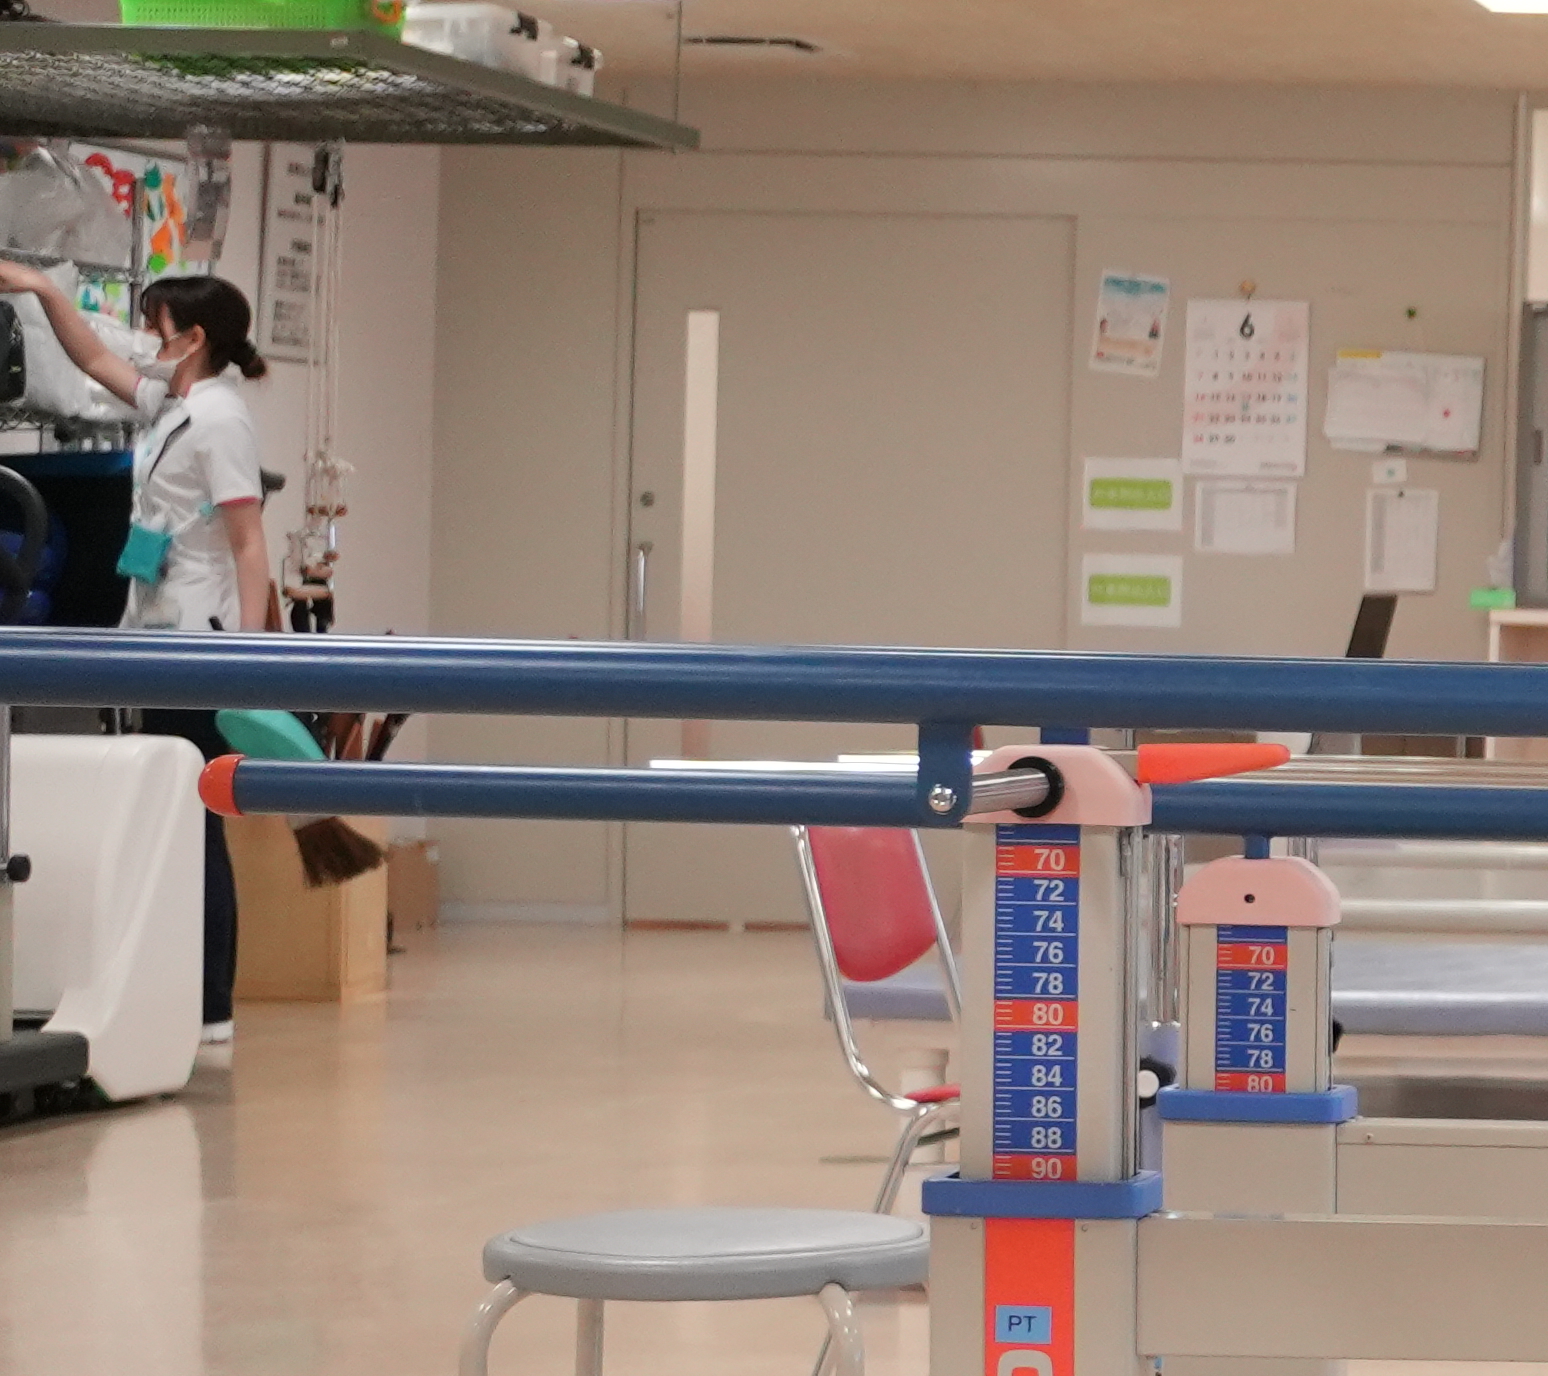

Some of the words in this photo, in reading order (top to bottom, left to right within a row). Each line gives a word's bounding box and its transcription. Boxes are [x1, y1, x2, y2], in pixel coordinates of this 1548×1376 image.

[1240, 313, 1255, 339] 6
[1033, 848, 1066, 871] 70
[1033, 879, 1065, 902] 72
[1032, 910, 1064, 933] 74
[1032, 941, 1064, 964] 76
[1248, 945, 1275, 965] 70
[1031, 972, 1064, 995] 78
[1247, 971, 1274, 991] 72
[1032, 1003, 1064, 1026] 80
[1247, 997, 1274, 1017] 74
[1031, 1033, 1063, 1056] 82
[1247, 1023, 1274, 1043] 76
[1246, 1049, 1273, 1069] 78
[1031, 1064, 1063, 1087] 84
[1247, 1075, 1273, 1093] 80
[1031, 1095, 1063, 1118] 86
[1030, 1126, 1063, 1149] 88
[1031, 1157, 1062, 1179] 90
[1007, 1314, 1037, 1334] PT
